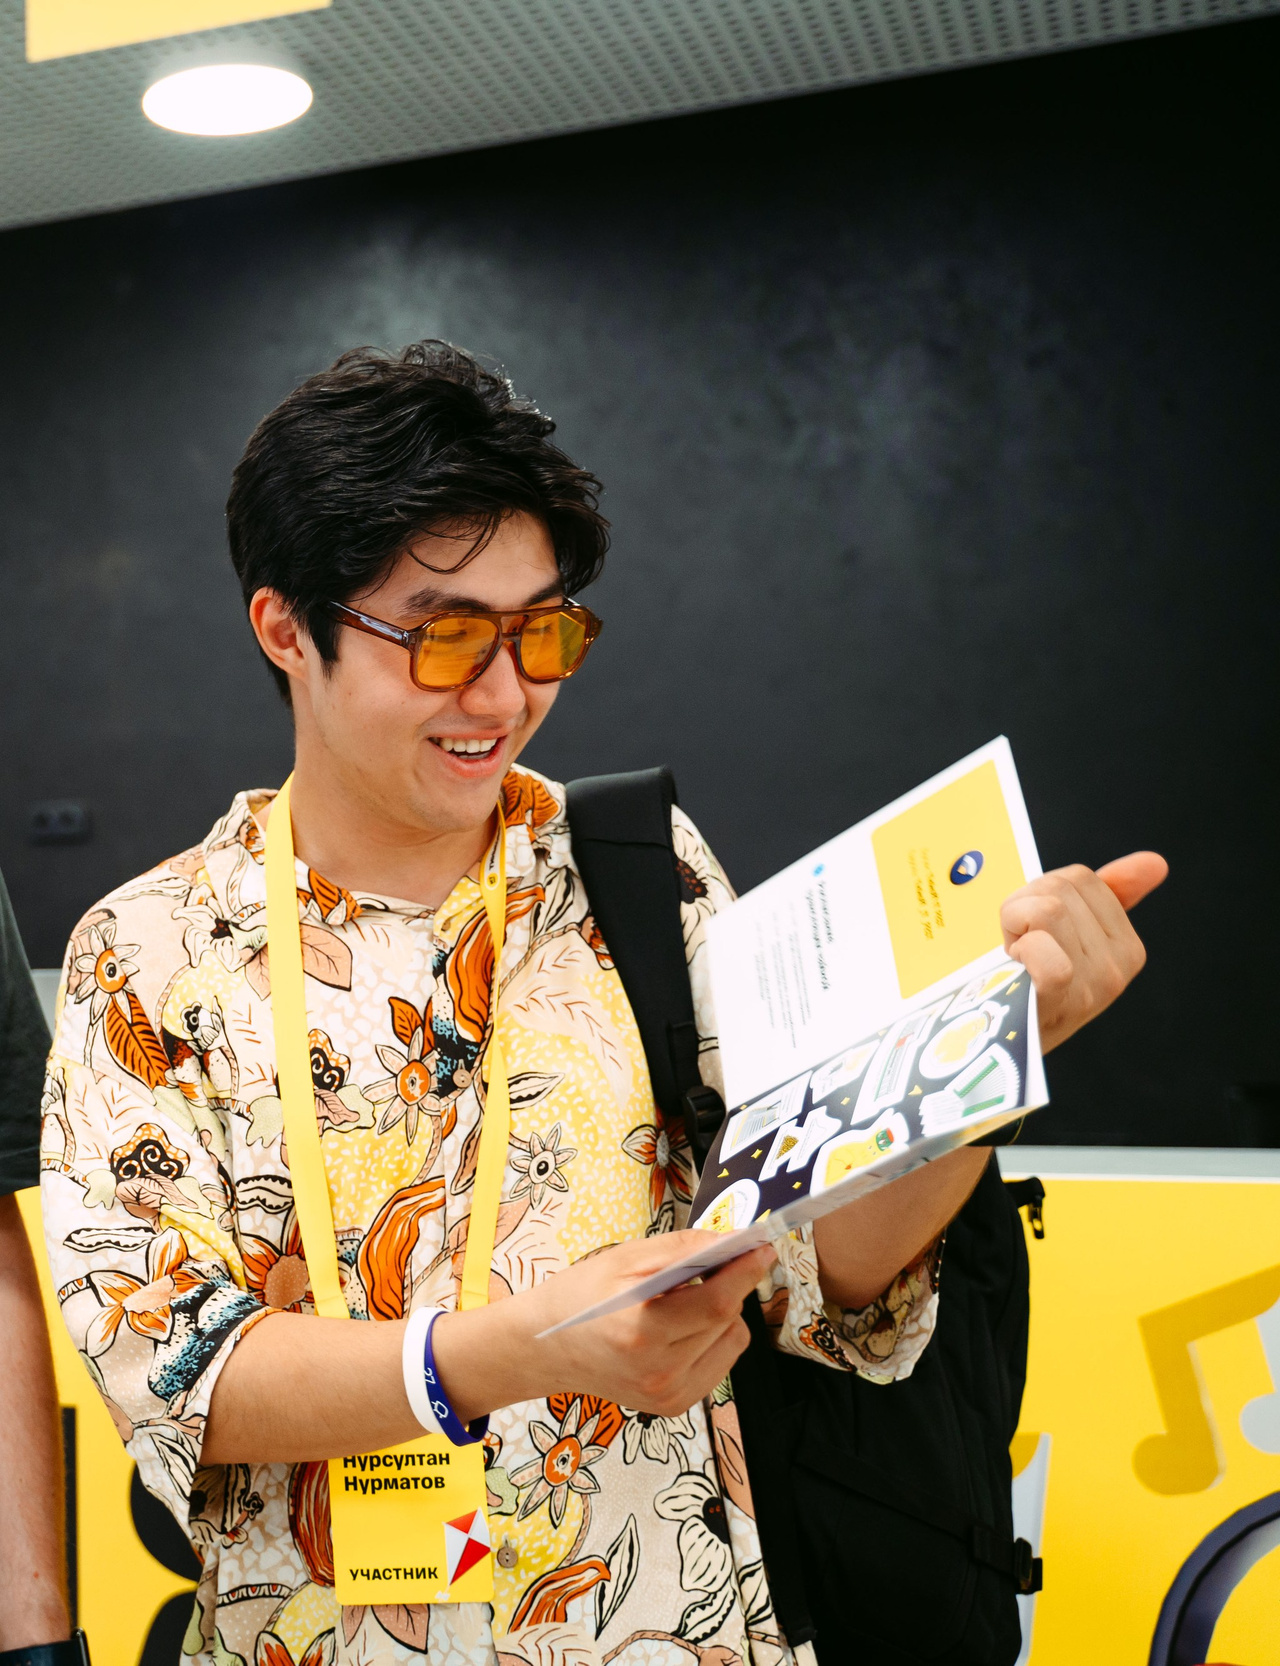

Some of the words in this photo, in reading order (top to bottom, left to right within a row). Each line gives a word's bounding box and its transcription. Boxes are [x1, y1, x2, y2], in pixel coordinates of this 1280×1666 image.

[343, 1453, 451, 1472] Нурсултан
[344, 1475, 446, 1495] Нурматов
[349, 1566, 439, 1581] УЧАСТНИК
